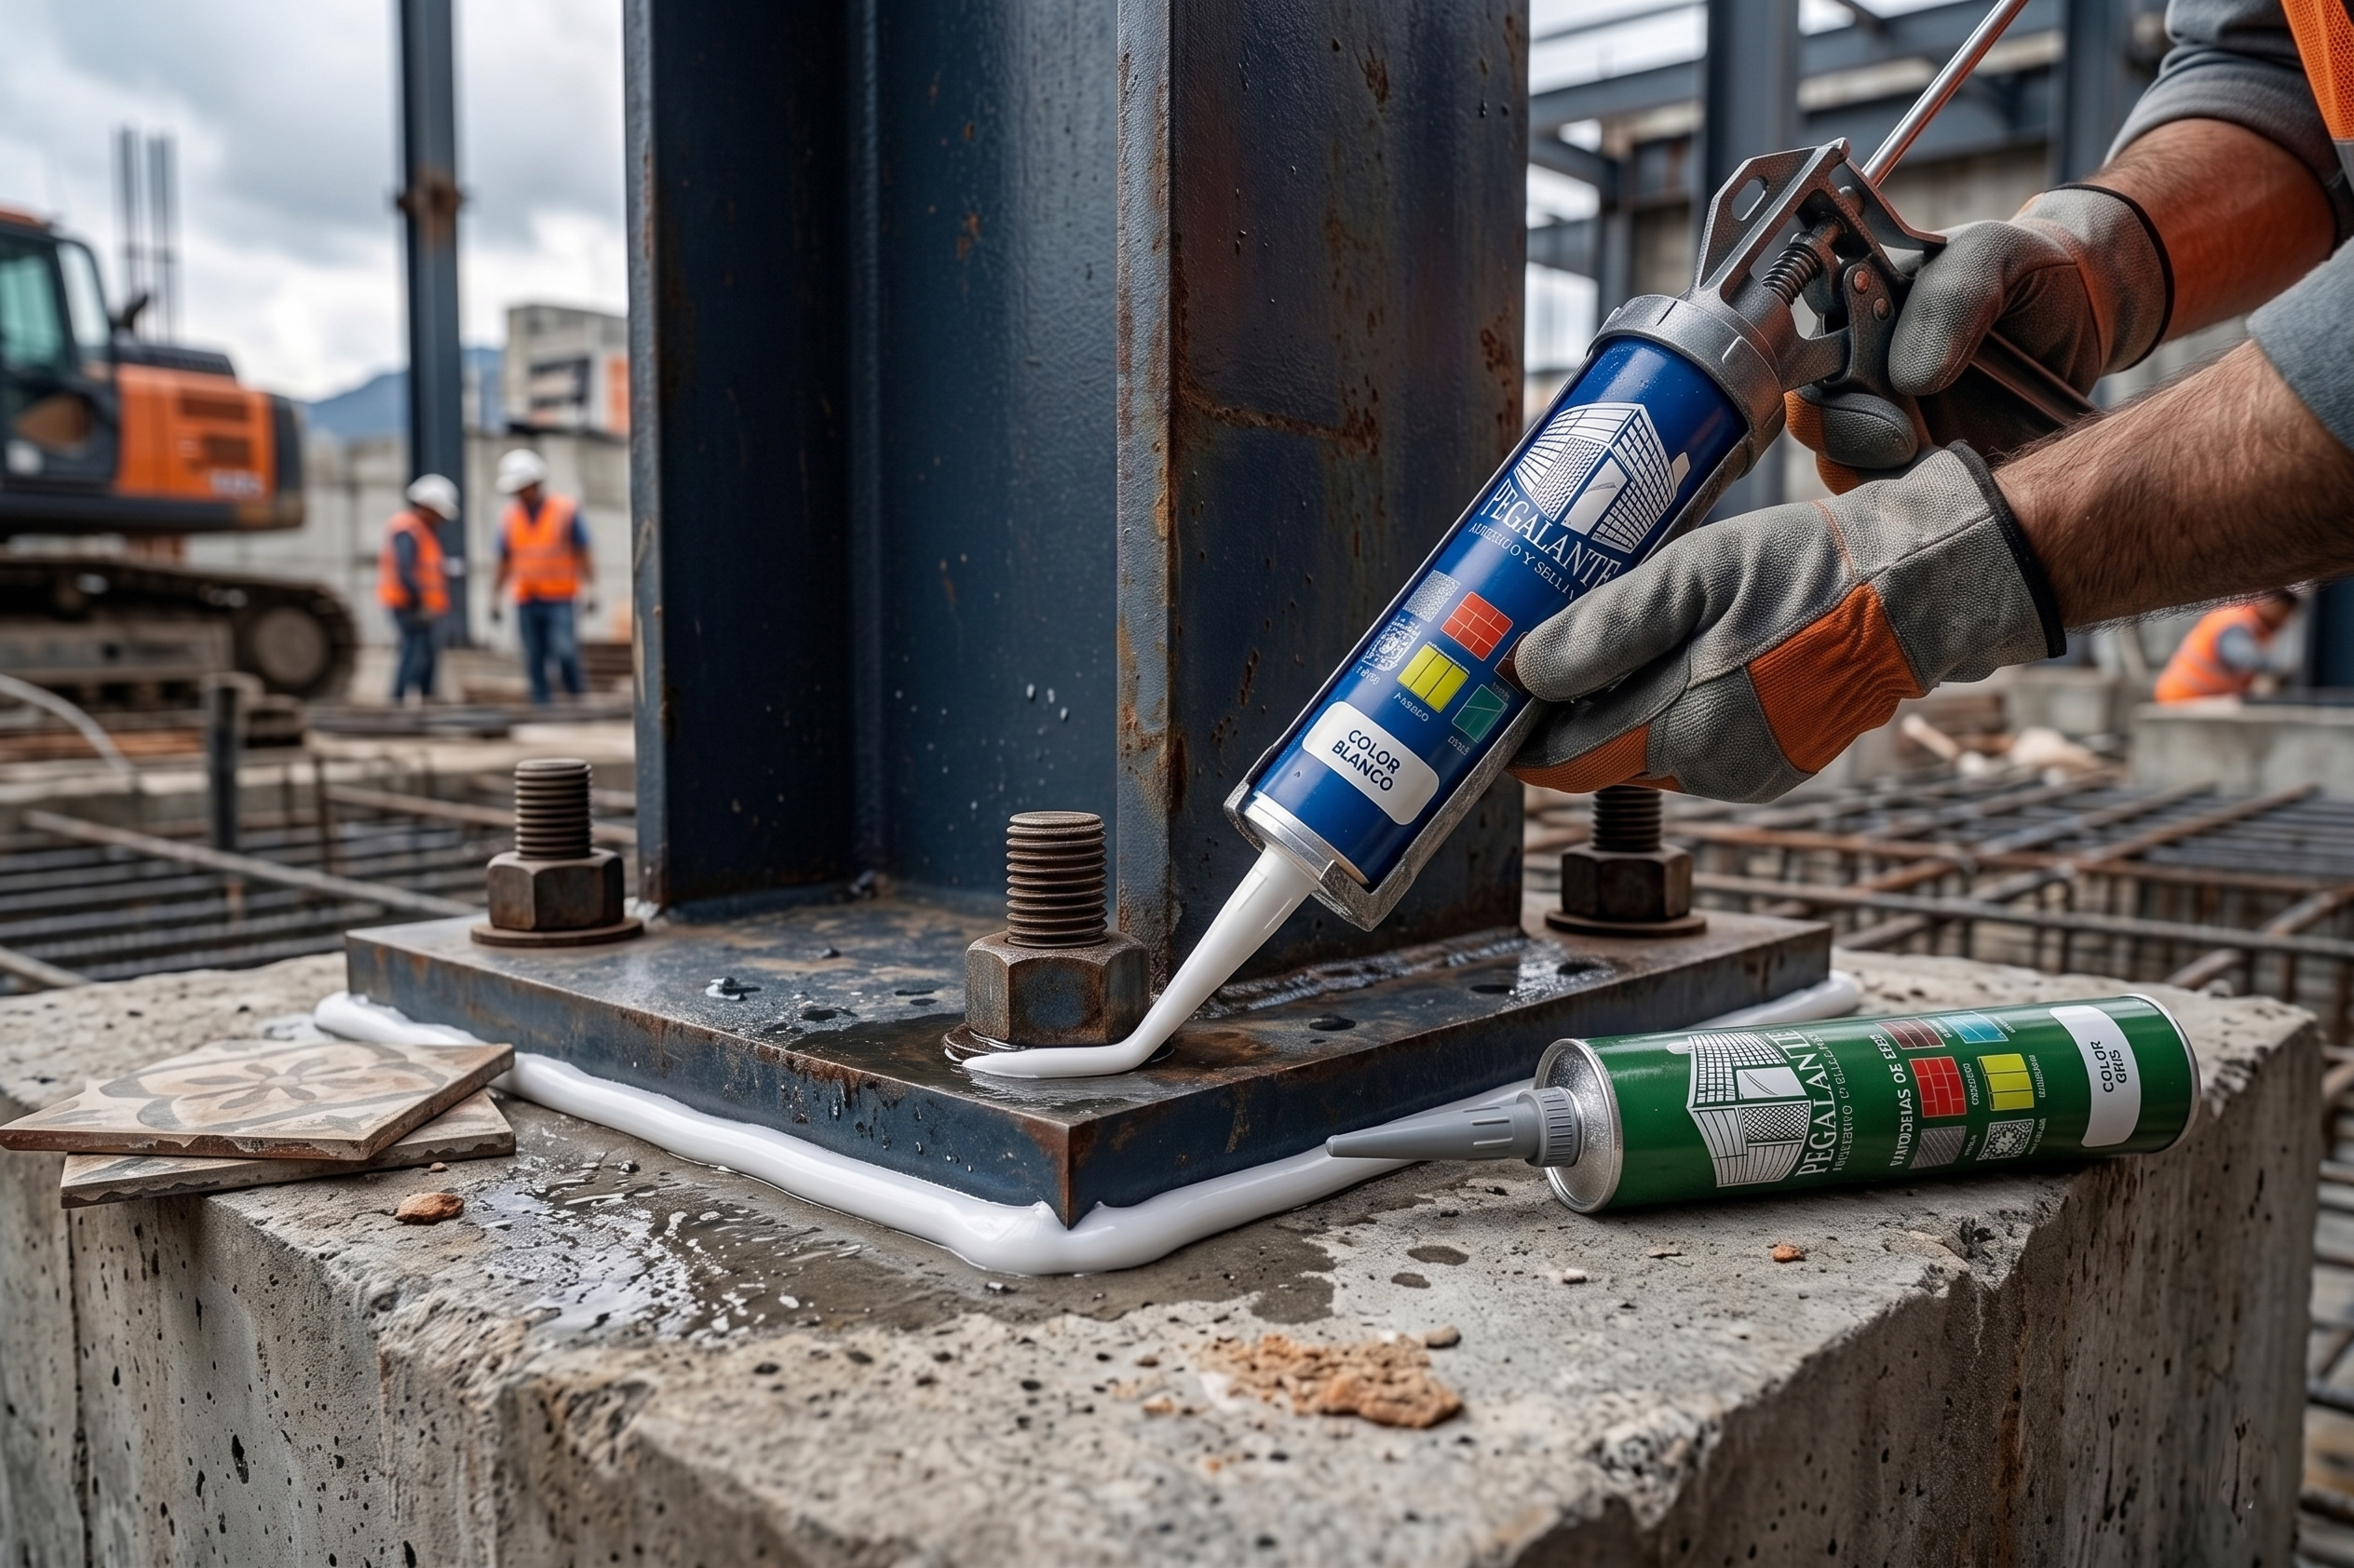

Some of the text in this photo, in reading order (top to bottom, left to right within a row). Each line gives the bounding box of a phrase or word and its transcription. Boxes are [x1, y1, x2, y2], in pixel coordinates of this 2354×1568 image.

[1481, 478, 1622, 591] PEGALANTE
[1332, 740, 1394, 791] BLANCO
[1348, 729, 1400, 775] COLOR
[2090, 1040, 2115, 1093] COLOR
